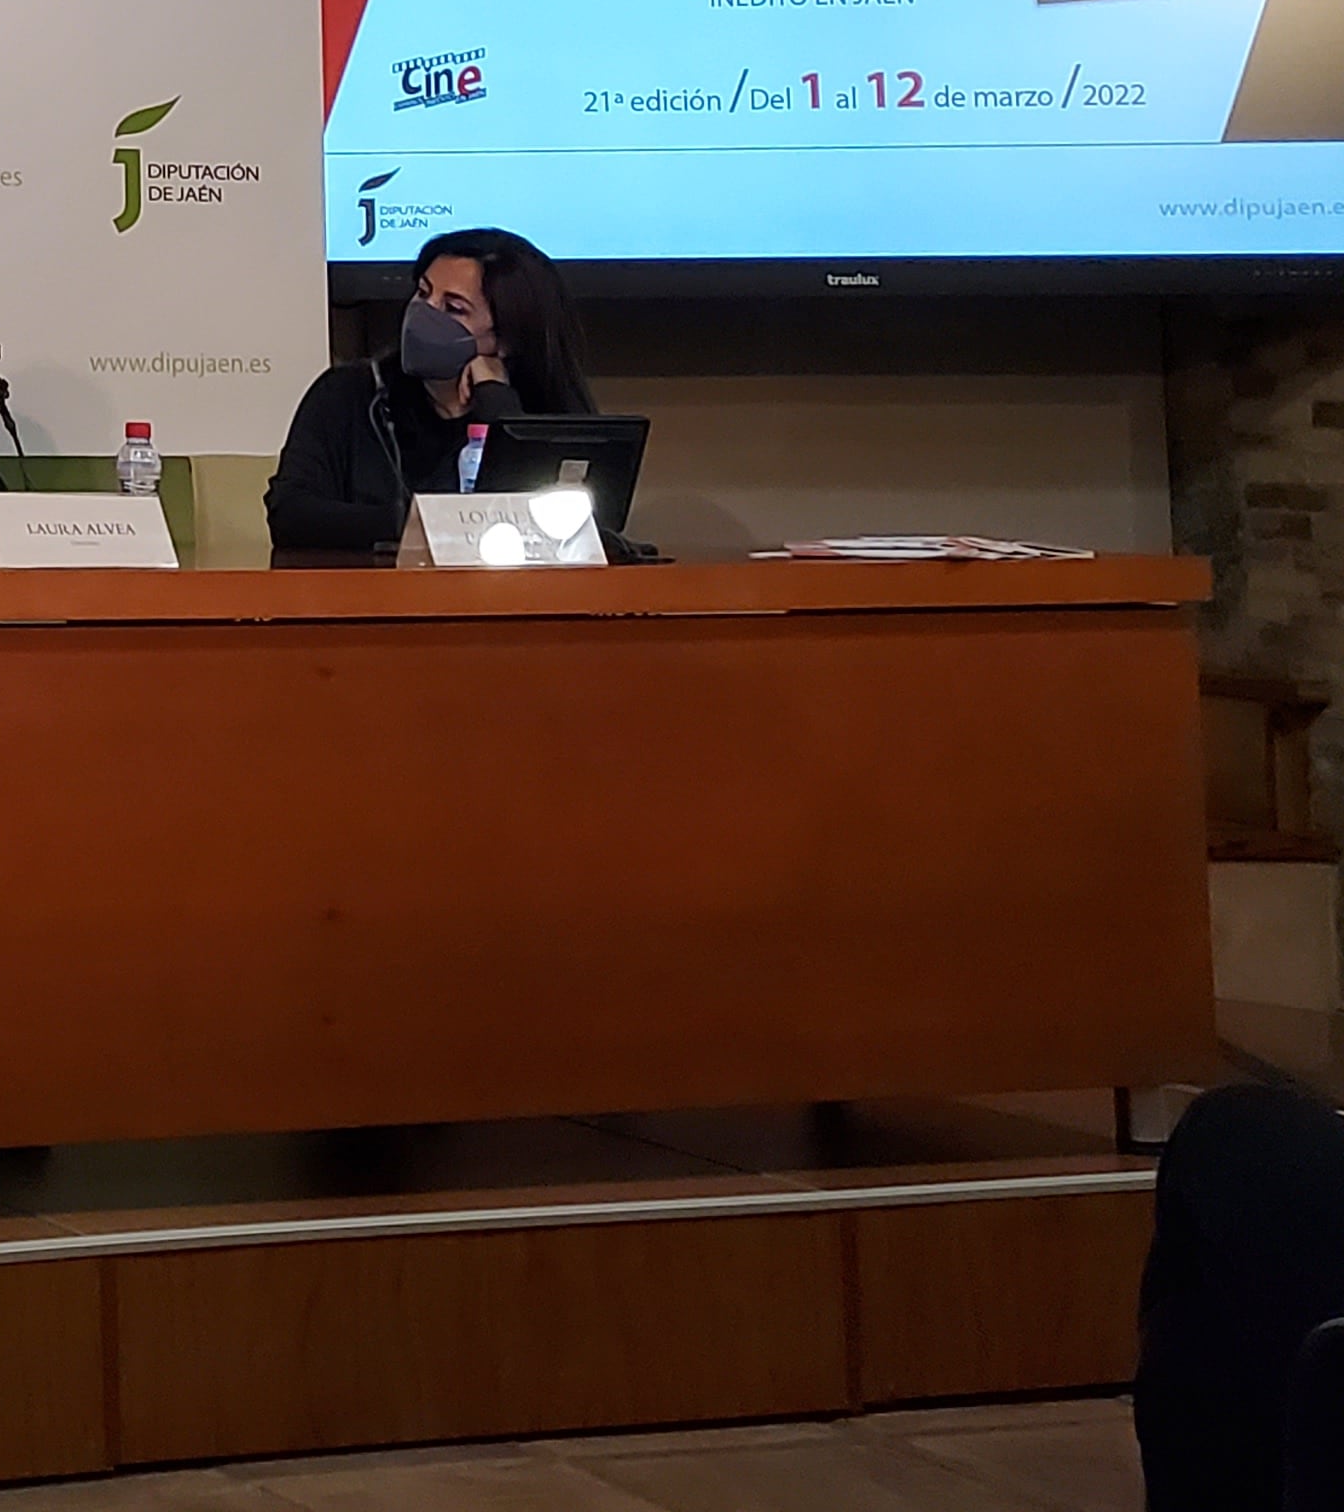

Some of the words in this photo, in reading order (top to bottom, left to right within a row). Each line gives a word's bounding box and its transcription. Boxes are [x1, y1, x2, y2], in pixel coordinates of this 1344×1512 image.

[630, 88, 722, 113] edición
[801, 72, 820, 109] 1
[835, 86, 857, 109] al
[867, 71, 925, 109] 12
[934, 85, 966, 108] de
[973, 89, 1053, 108] marzo
[147, 163, 260, 181] DIPUTACIÓN
[148, 186, 173, 202] DE
[176, 184, 222, 203] JAÉN
[1159, 197, 1344, 221] www.dipujaen.e
[89, 351, 272, 378] www.dipujaen.es
[26, 522, 82, 536] LAURA
[86, 522, 136, 536] ALVEA
